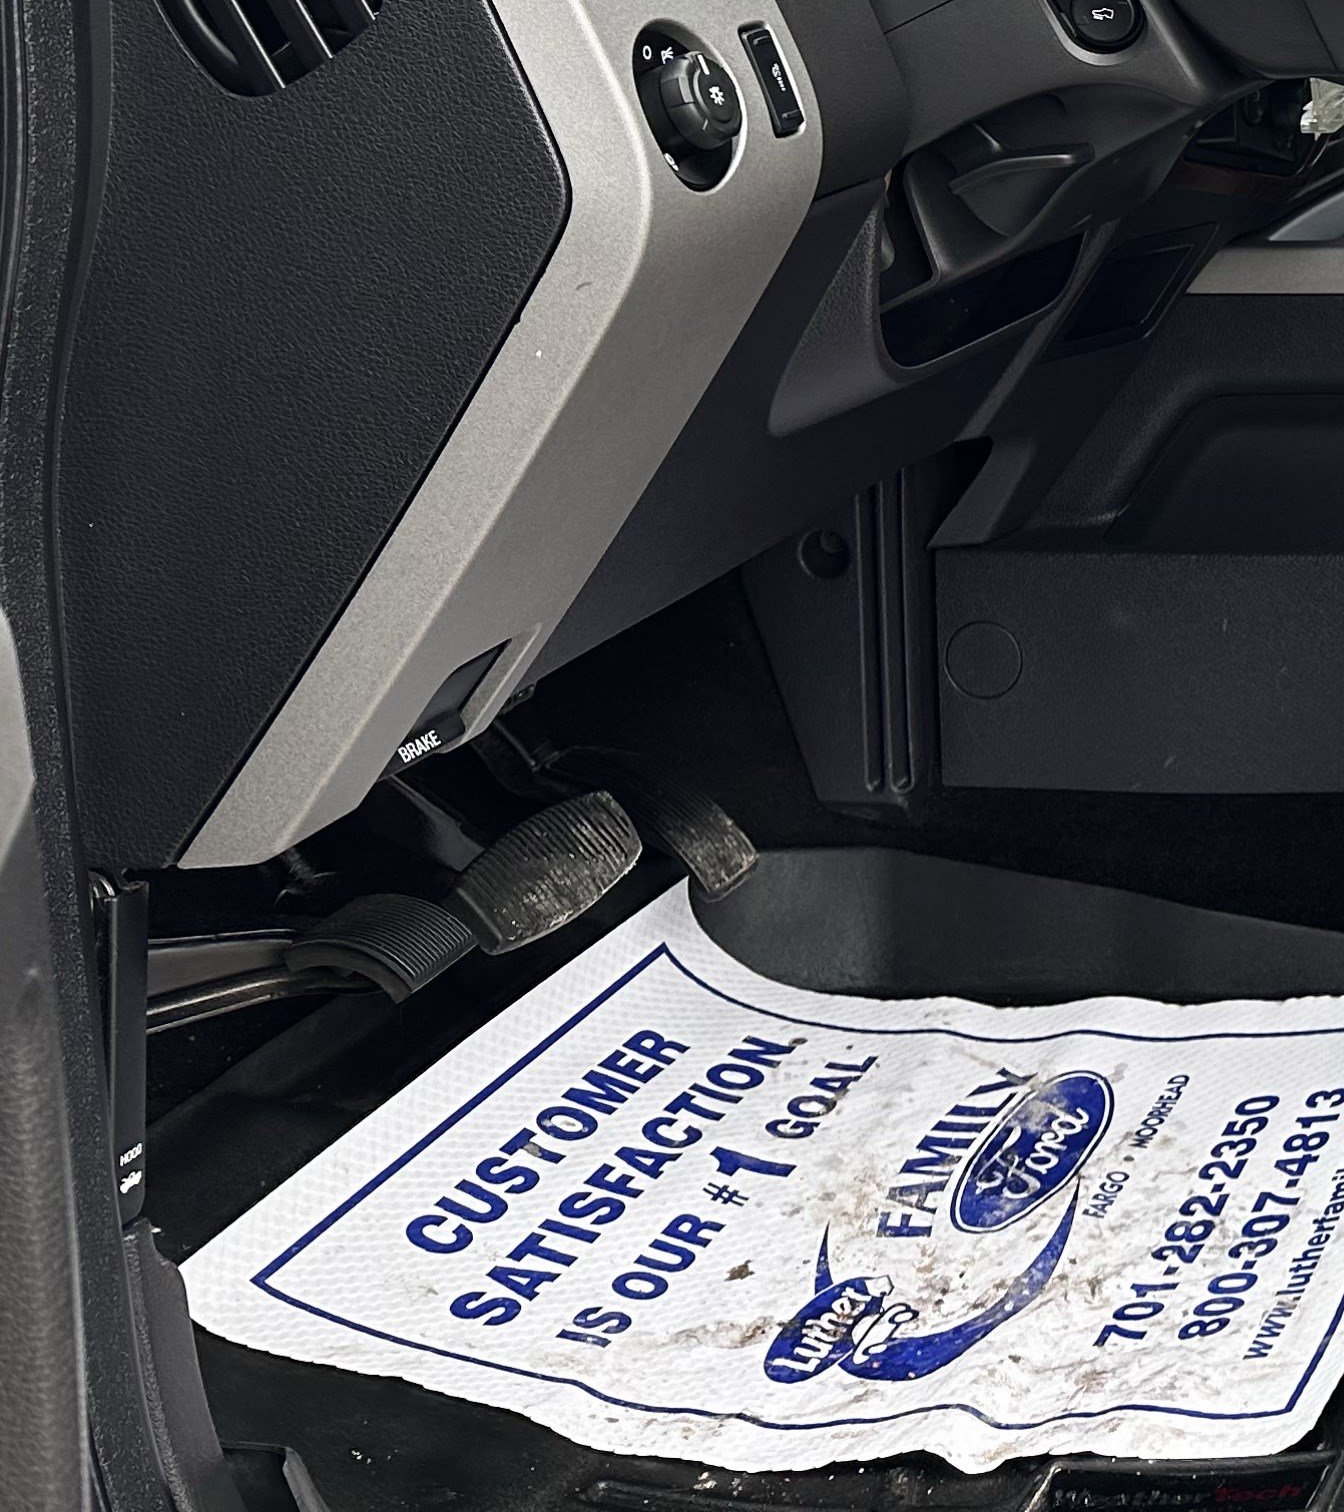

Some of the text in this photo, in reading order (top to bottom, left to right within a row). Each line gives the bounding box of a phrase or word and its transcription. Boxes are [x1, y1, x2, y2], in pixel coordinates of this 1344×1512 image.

[398, 729, 442, 764] BRAKE
[119, 1142, 143, 1167] HOOD
[405, 1029, 691, 1254] CUSTOMER
[555, 1306, 633, 1349] IS
[611, 1212, 726, 1300] OUR
[765, 1055, 879, 1140] GOAL
[876, 1066, 1040, 1239] FAMILY
[976, 1105, 1090, 1201] Ford
[1083, 1074, 1191, 1220] FARGO MOORHEAD
[1092, 1094, 1280, 1348] 701-282-2350
[772, 1284, 880, 1375] Luther
